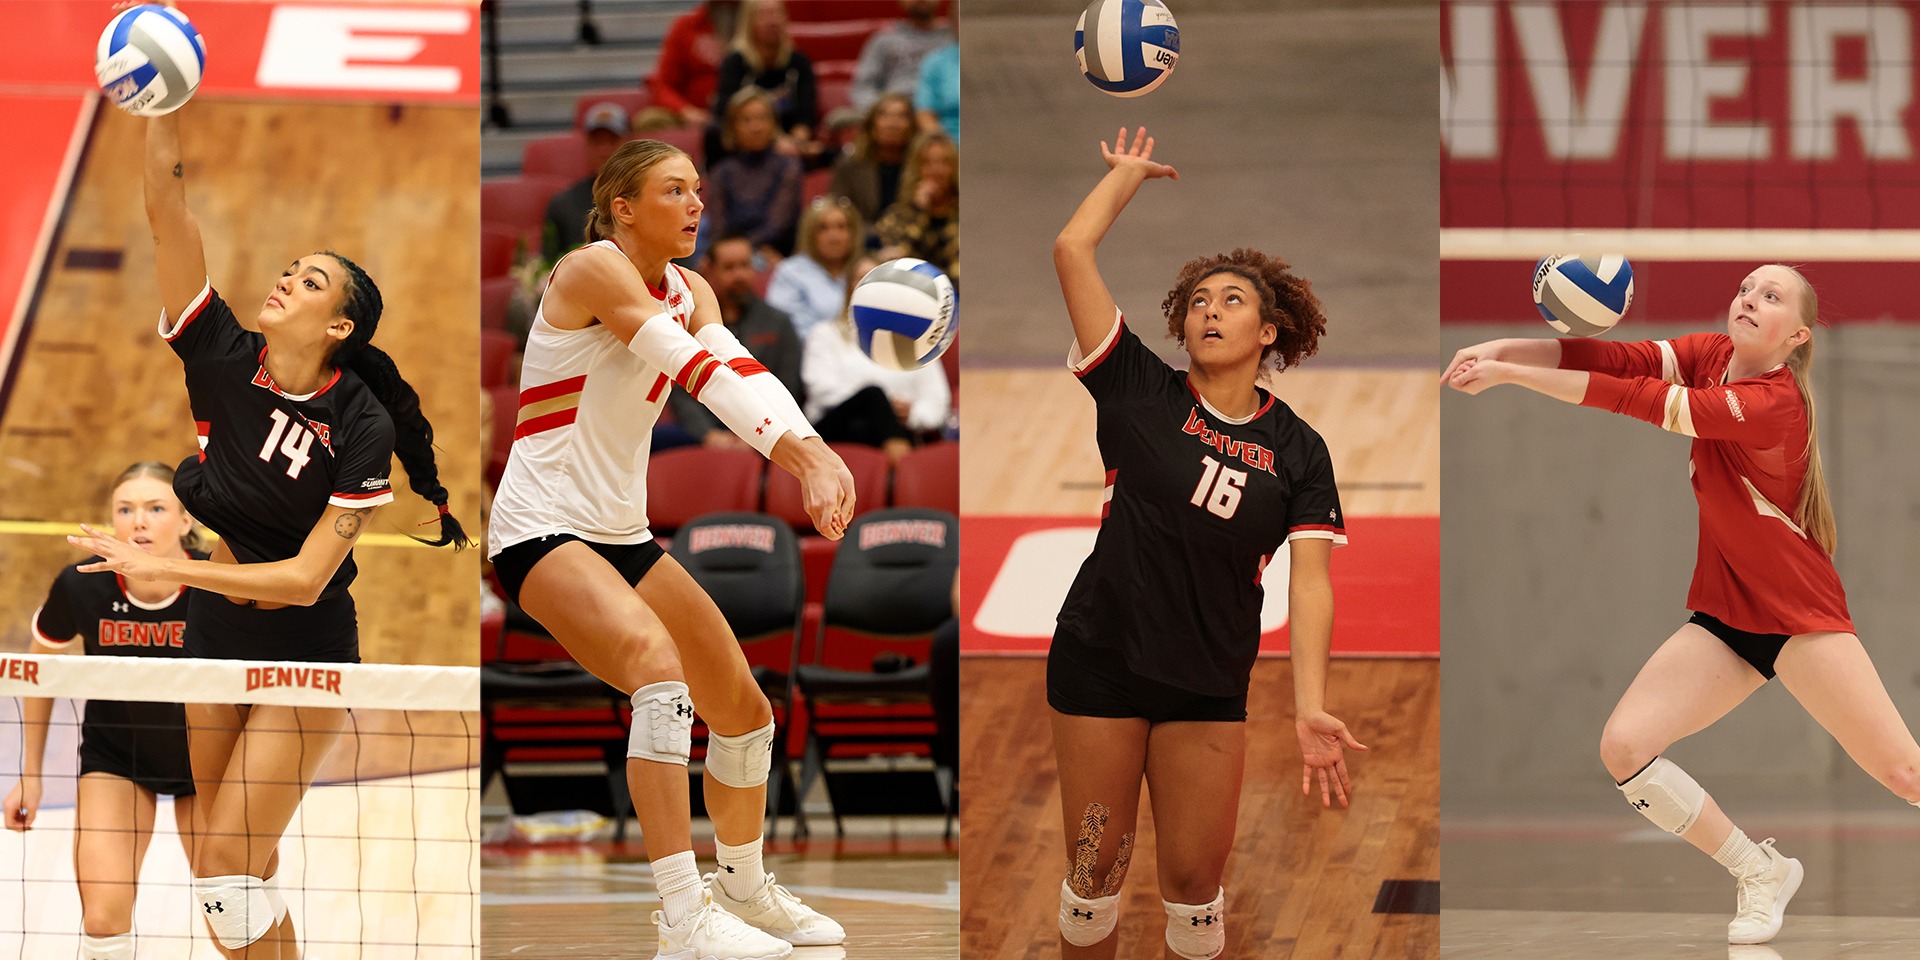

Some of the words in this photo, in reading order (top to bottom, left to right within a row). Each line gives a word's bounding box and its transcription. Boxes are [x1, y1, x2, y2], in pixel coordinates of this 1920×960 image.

[256, 5, 471, 93] E
[1533, 253, 1563, 293] olten
[258, 407, 312, 480] 14
[1181, 405, 1278, 477] DENVER
[1190, 454, 1248, 520] 16
[99, 619, 186, 648] DENVE
[246, 666, 341, 696] DENVER
